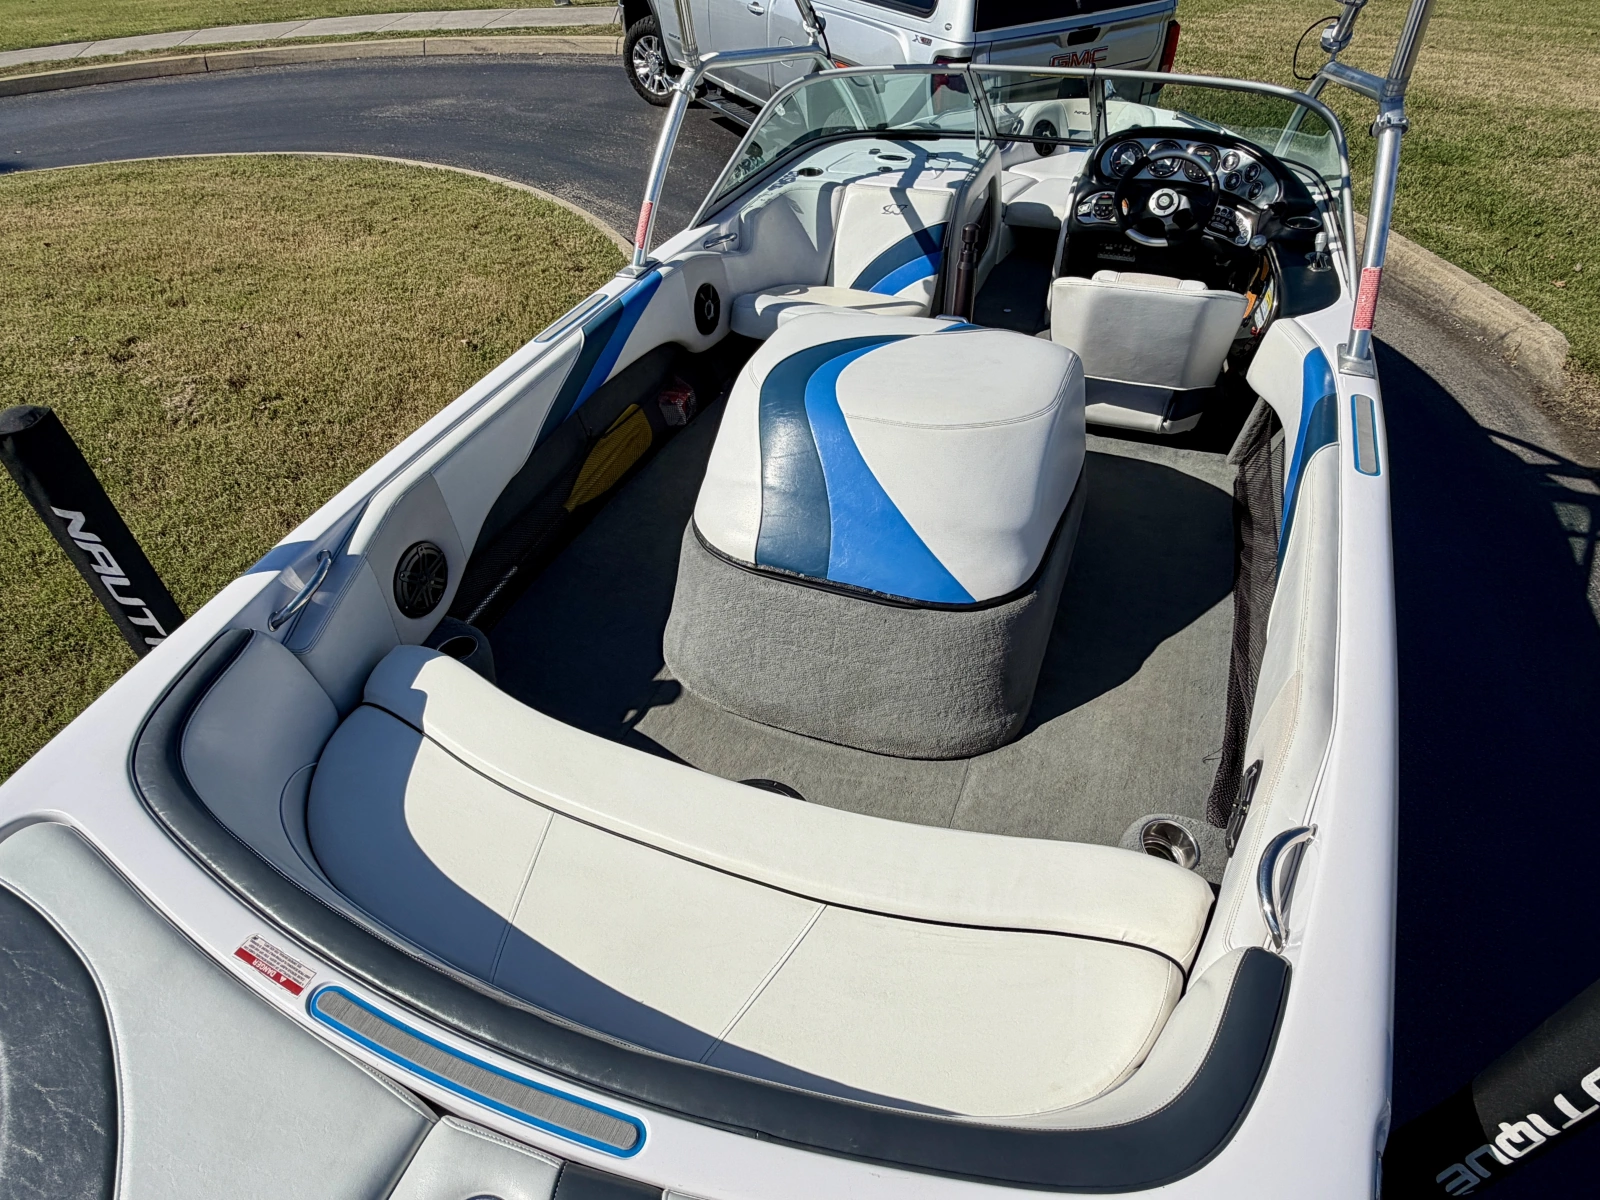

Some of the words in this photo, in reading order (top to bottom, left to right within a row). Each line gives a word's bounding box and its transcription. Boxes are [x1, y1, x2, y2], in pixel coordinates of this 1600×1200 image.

[1050, 46, 1109, 67] GMC
[51, 506, 167, 650] NAUTI
[252, 958, 277, 978] DANGER
